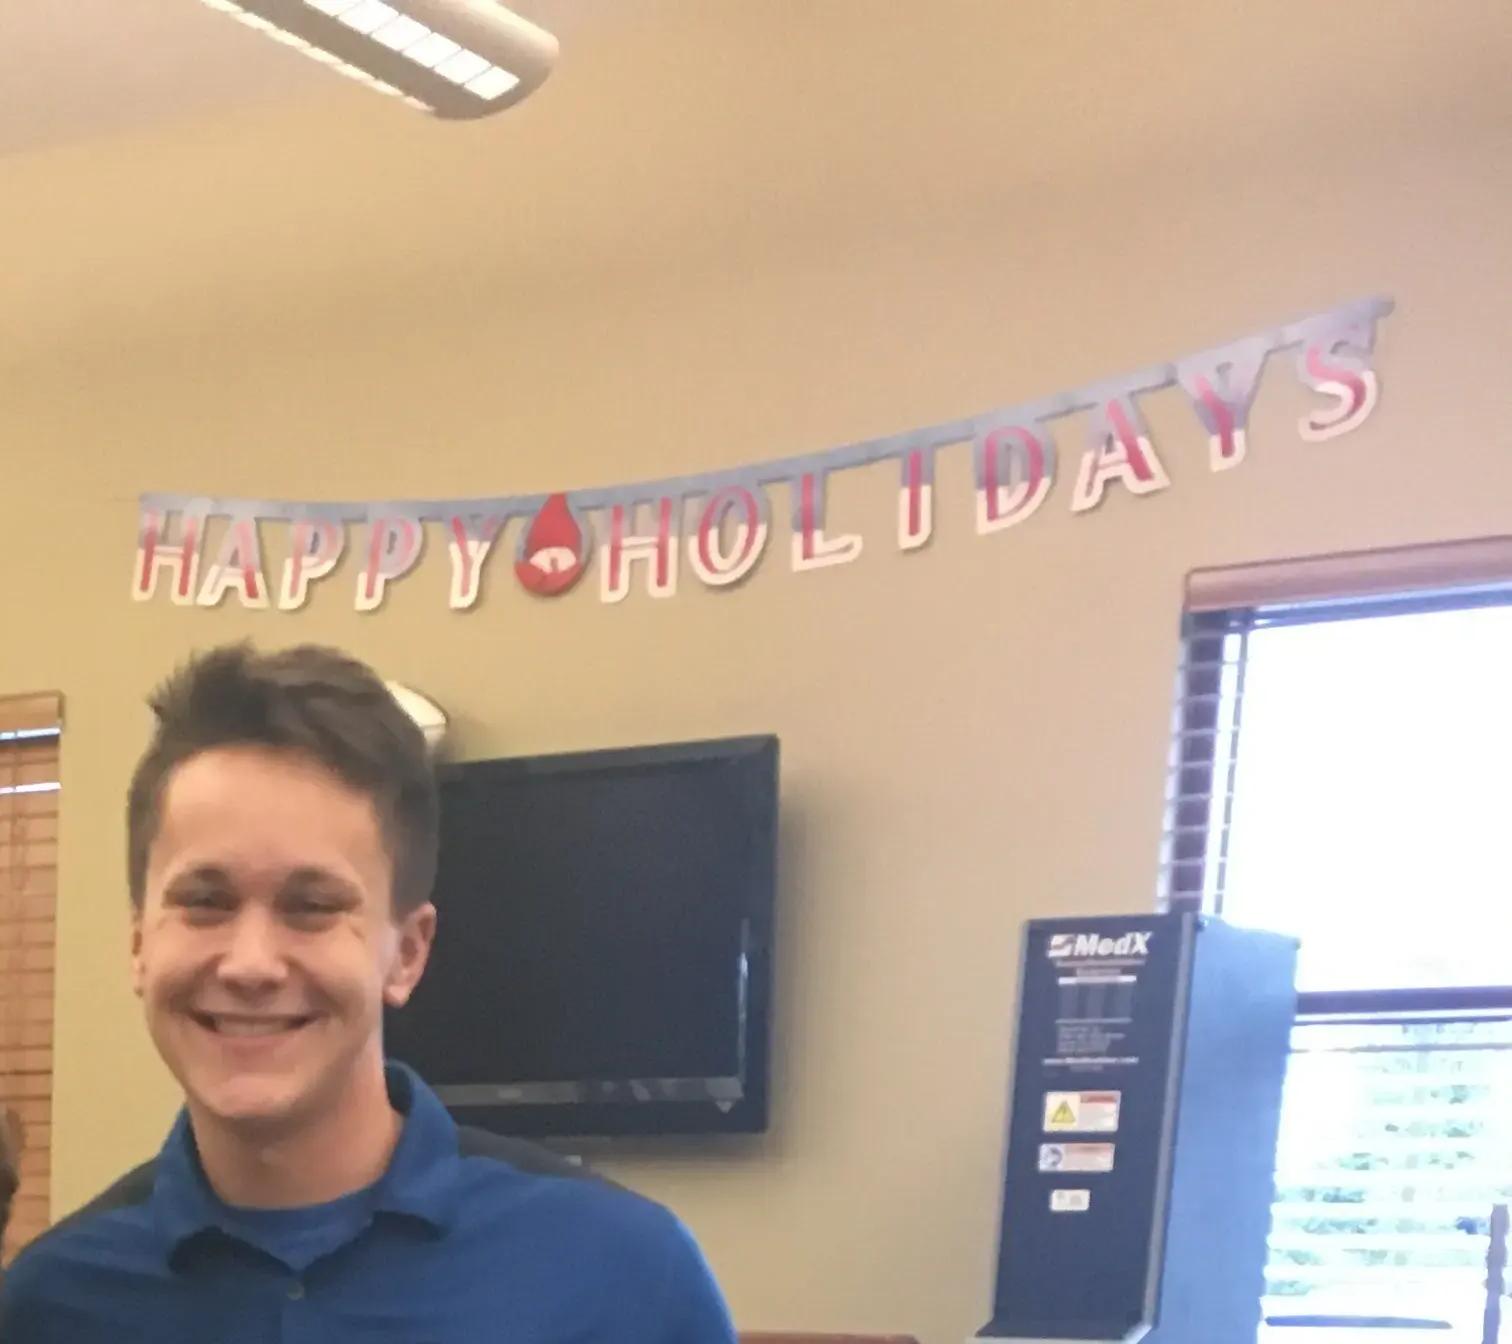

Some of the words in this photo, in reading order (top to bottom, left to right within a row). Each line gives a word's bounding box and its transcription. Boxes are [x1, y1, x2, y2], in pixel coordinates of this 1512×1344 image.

[132, 494, 504, 611] HAPPY
[598, 328, 1378, 603] HOLIDAYS
[1073, 931, 1153, 957] MedX
